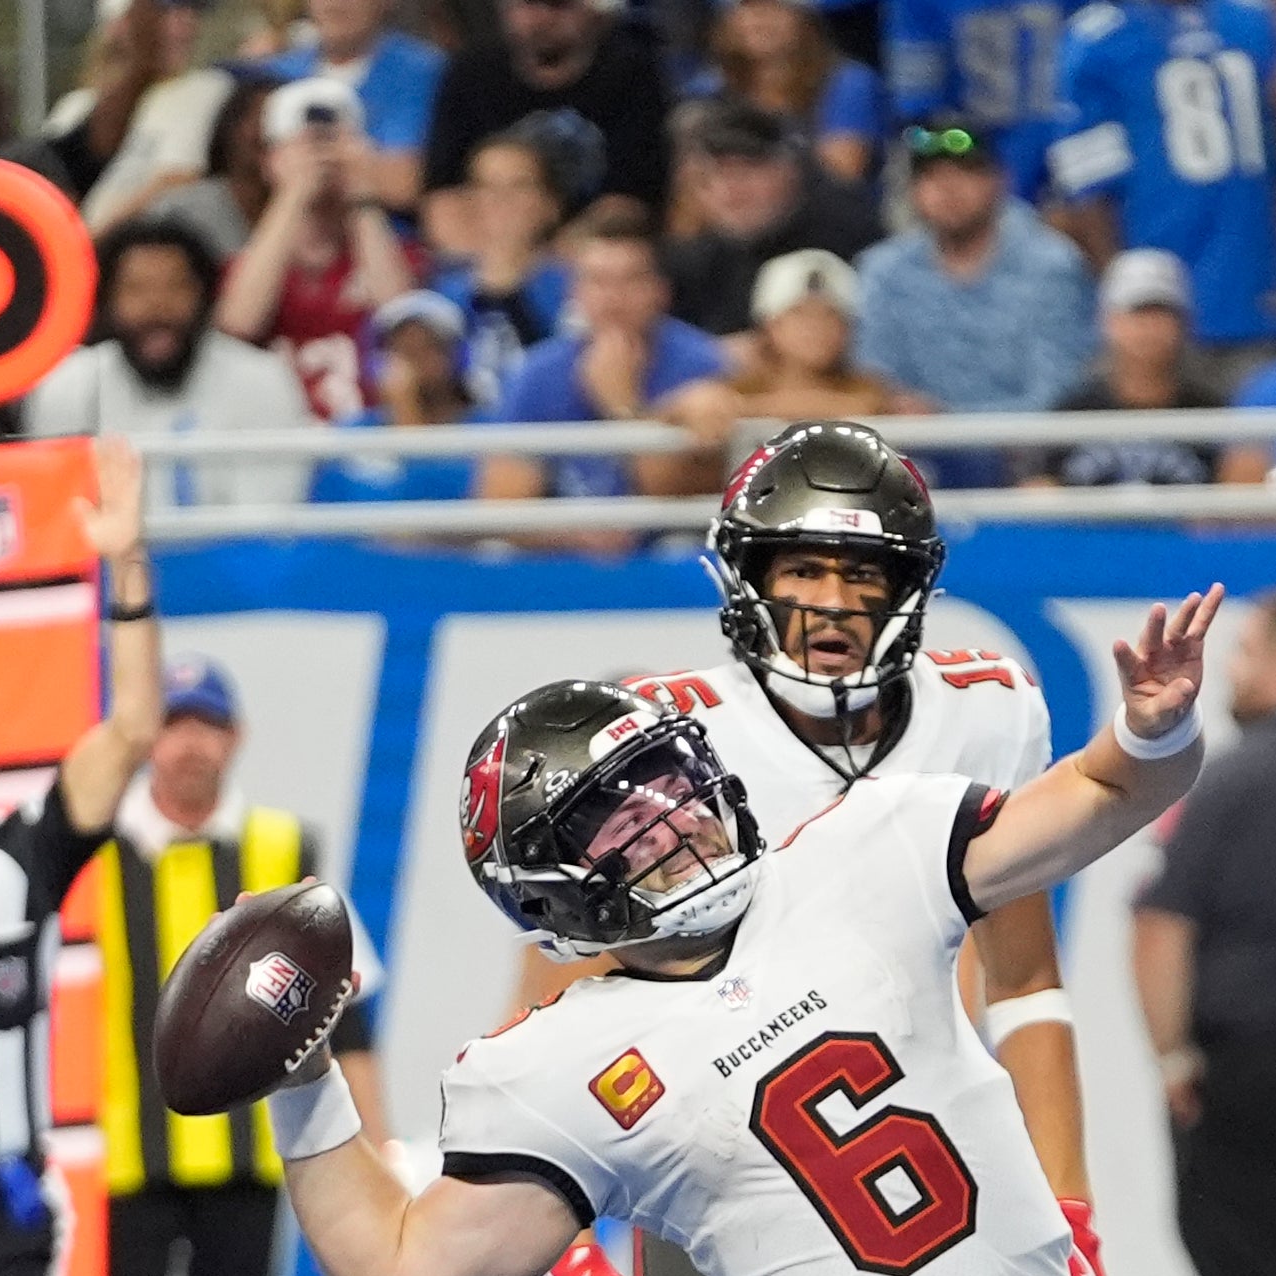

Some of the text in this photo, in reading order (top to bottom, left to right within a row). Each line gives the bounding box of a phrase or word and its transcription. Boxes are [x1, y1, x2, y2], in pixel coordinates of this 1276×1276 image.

[1156, 49, 1267, 183] 81
[711, 988, 829, 1080] BUCCANEERS
[596, 1053, 652, 1113] C
